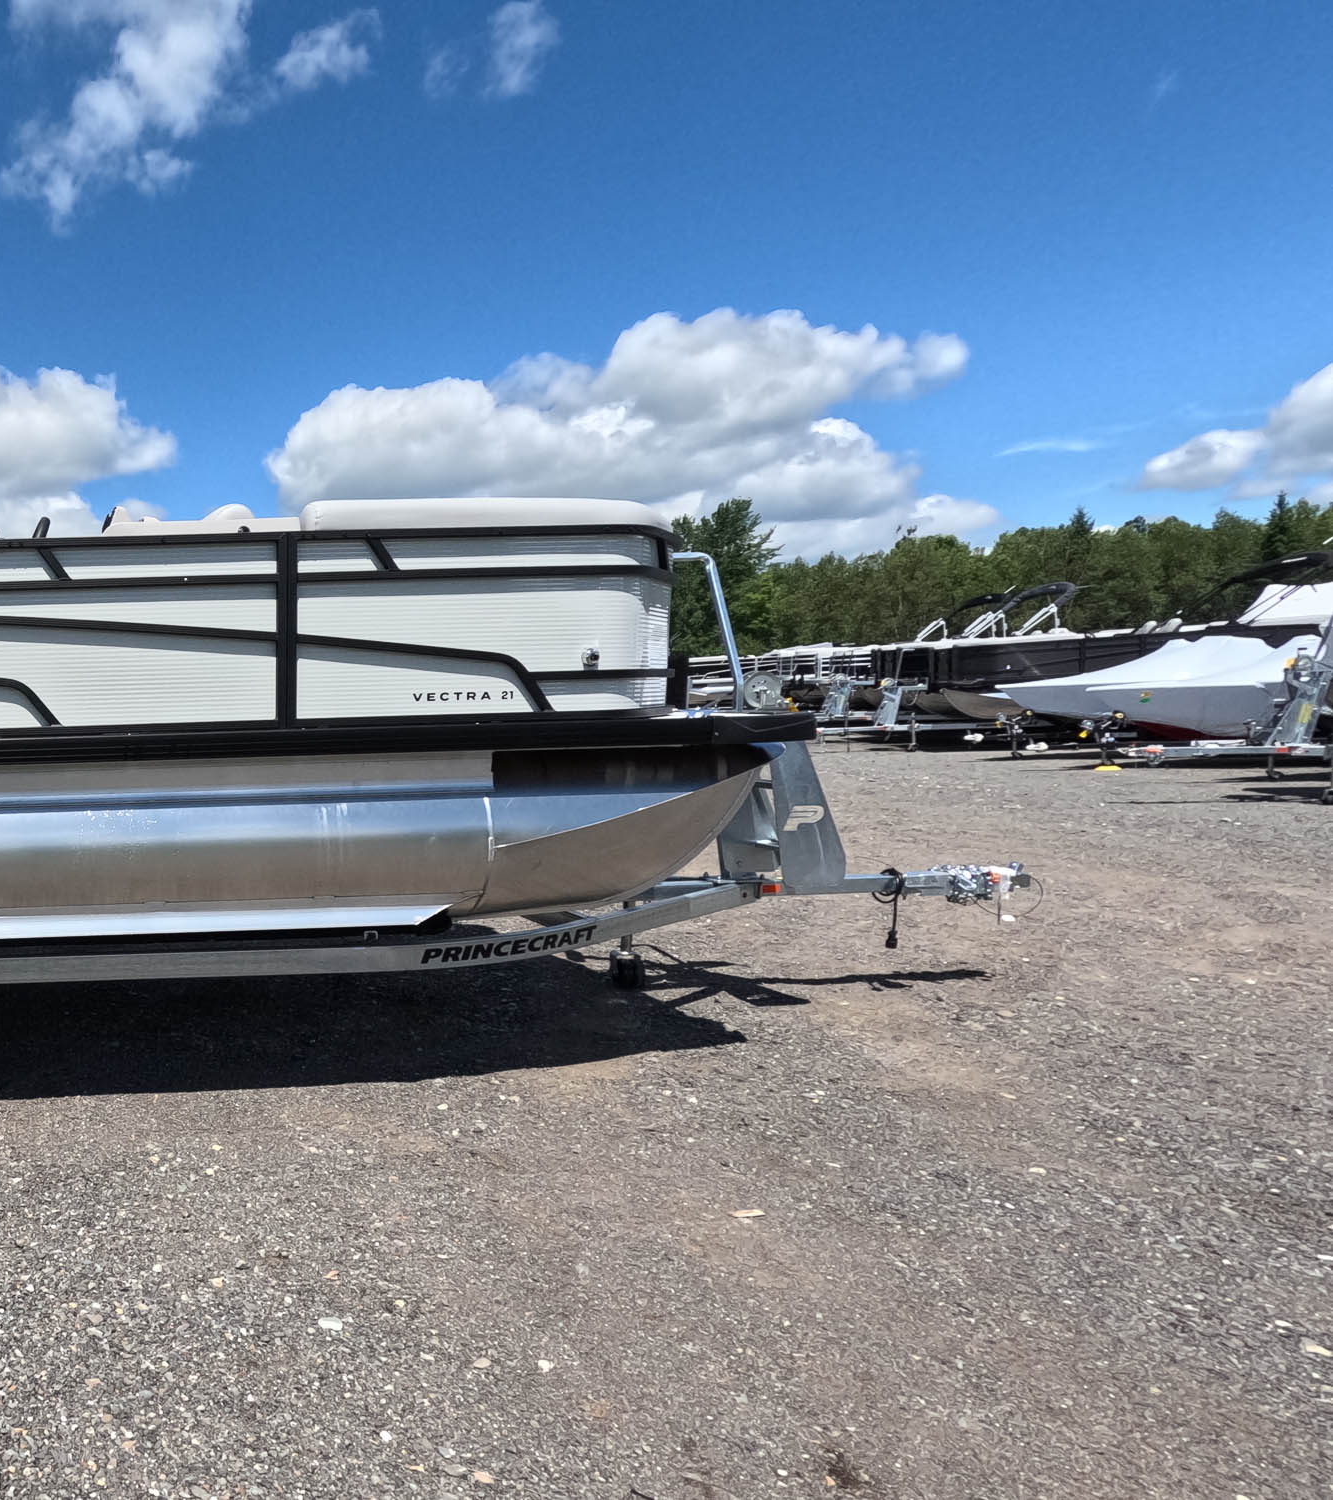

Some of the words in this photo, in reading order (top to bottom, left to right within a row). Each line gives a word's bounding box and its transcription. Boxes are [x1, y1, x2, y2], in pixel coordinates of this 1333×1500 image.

[412, 691, 492, 702] VECTRA
[501, 690, 514, 700] 21
[420, 925, 598, 965] PRINCECRAFT
